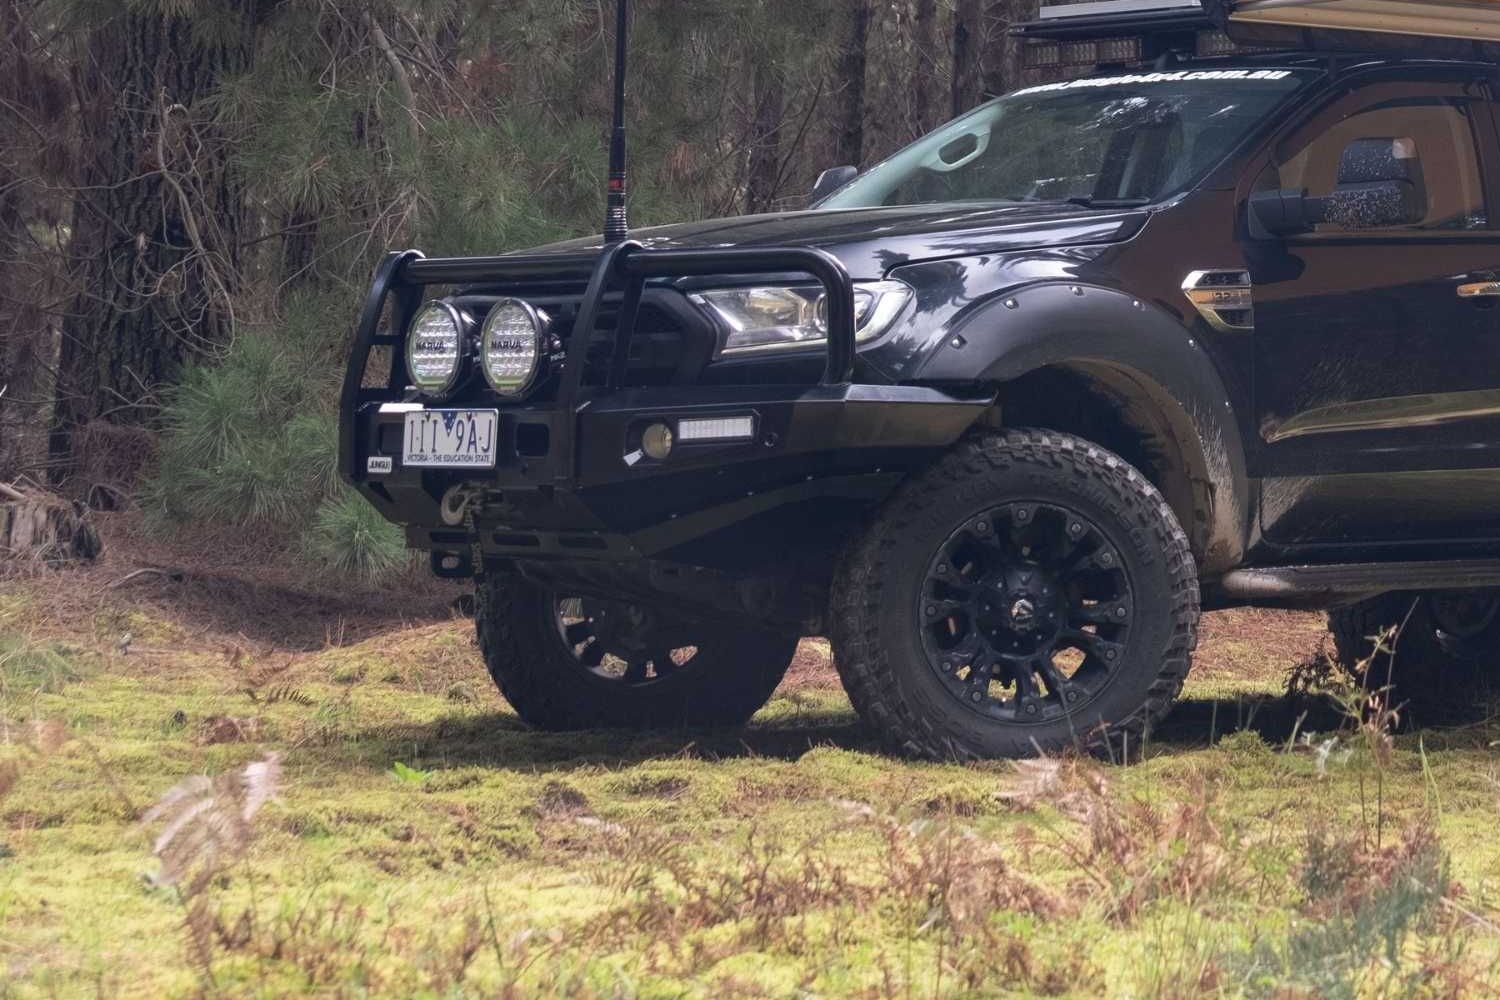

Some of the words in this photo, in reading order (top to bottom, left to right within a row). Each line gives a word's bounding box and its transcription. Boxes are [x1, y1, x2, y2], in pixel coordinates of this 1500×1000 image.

[416, 340, 445, 351] NARVA
[491, 340, 522, 350] NARVA
[407, 454, 428, 462] VICTORIA
[433, 454, 442, 462] THE
[443, 454, 473, 462] EDUCATION
[475, 454, 490, 462] STATE
